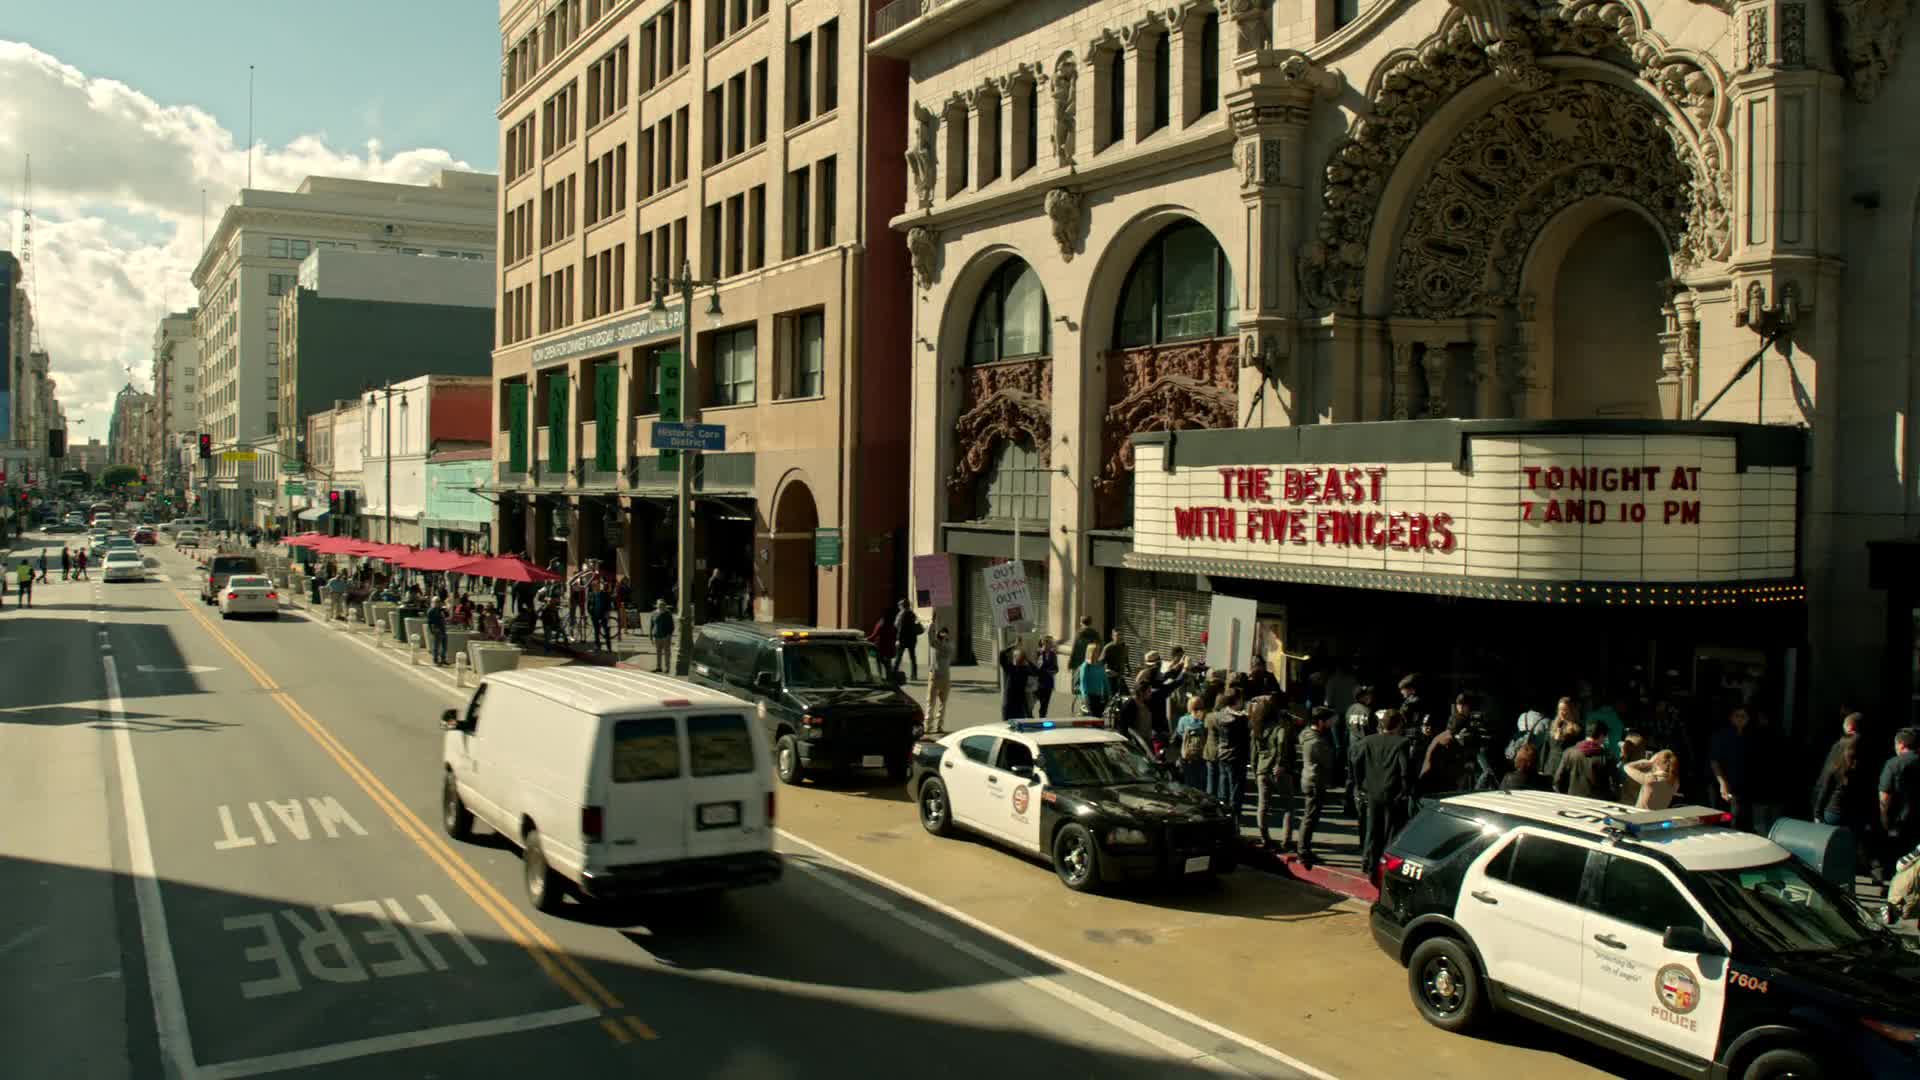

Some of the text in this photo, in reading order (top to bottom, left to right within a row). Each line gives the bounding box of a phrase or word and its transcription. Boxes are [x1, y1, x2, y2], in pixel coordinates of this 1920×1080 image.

[1218, 465, 1387, 505] THE BEAST
[1523, 465, 1701, 491] TONIGHT AT
[1520, 500, 1701, 524] 7 AND 10 PM
[1174, 506, 1458, 554] WITH FIVE FINGERS
[993, 566, 1015, 579] OUT
[213, 796, 368, 850] WAIT
[1401, 863, 1423, 881] 911
[223, 895, 488, 999] HERE
[1729, 970, 1768, 993] 7604
[1651, 1006, 1697, 1032] POLICE
